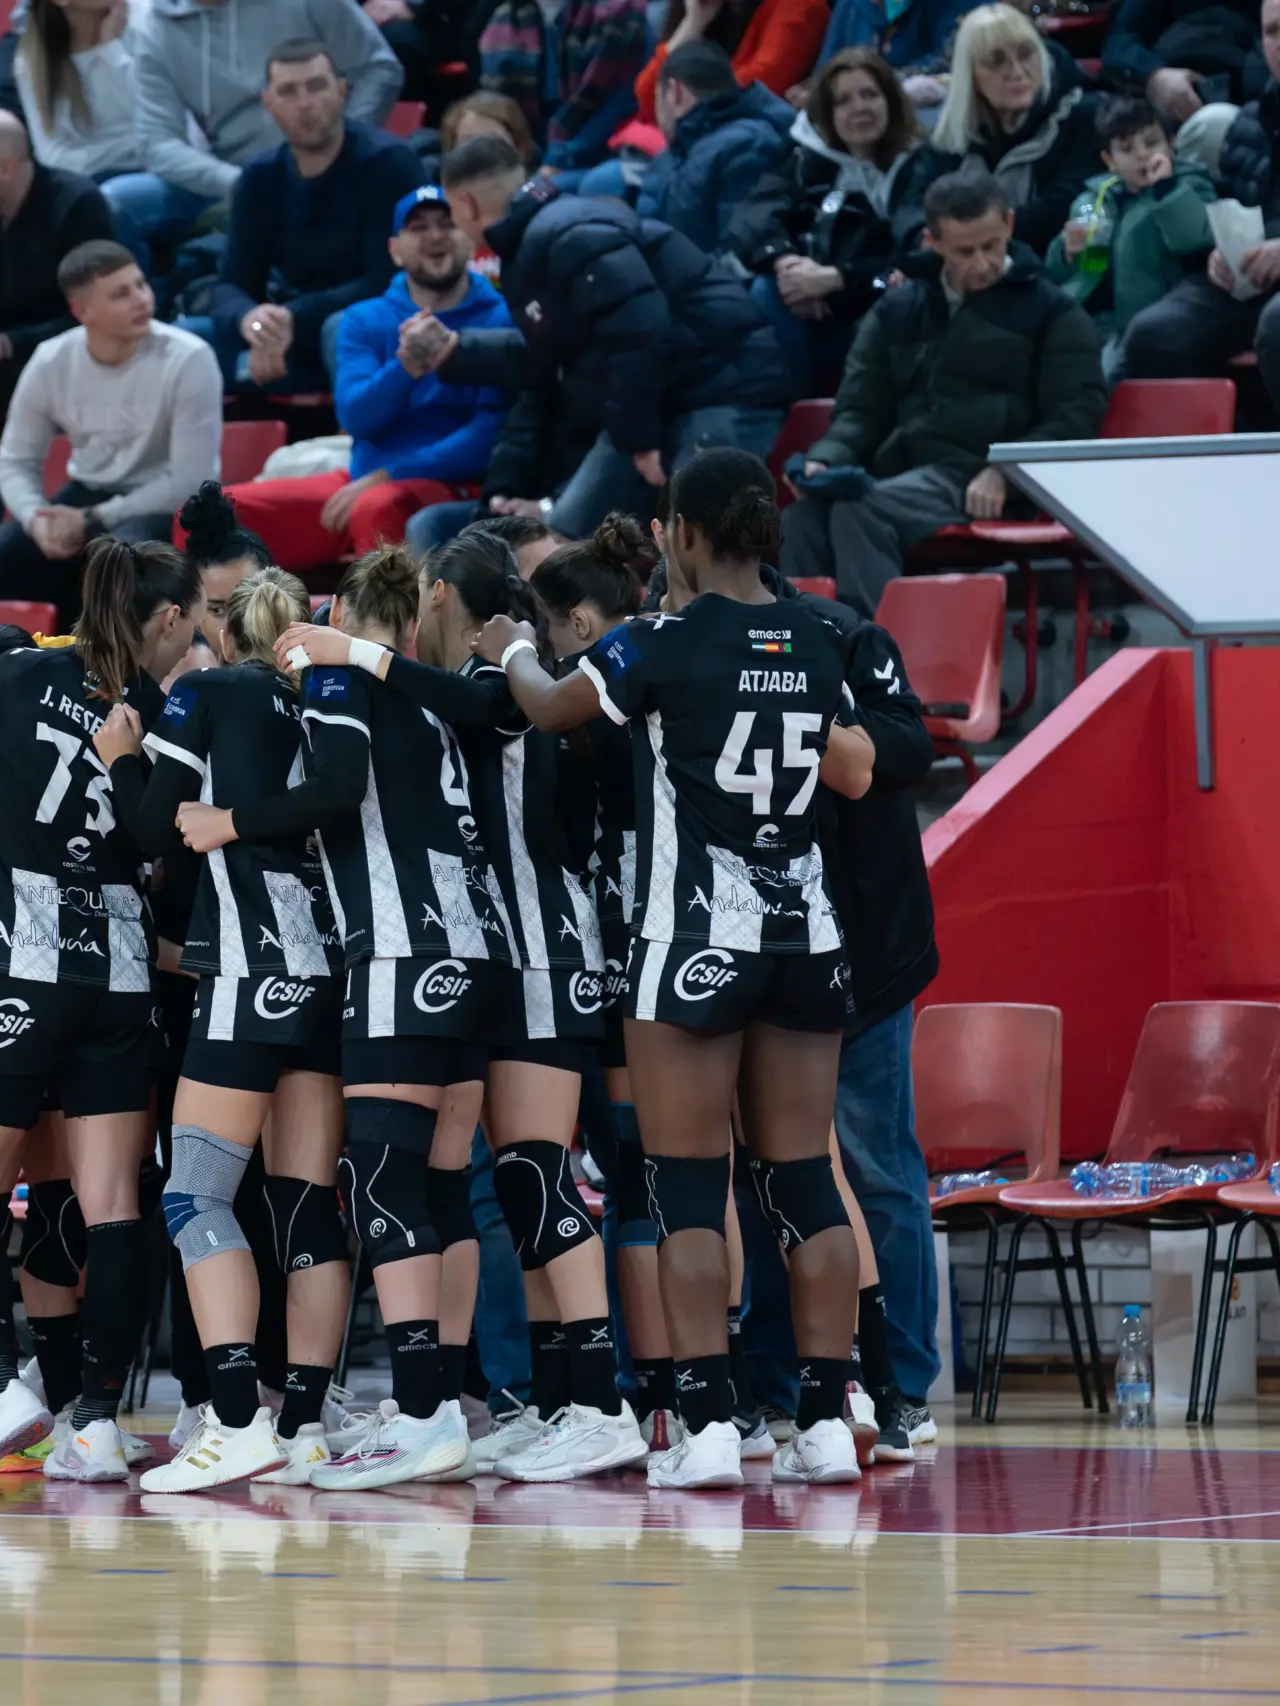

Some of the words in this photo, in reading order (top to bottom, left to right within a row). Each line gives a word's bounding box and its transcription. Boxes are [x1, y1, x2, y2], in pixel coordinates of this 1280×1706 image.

[738, 670, 808, 693] ATJABA
[40, 685, 54, 707] J.
[272, 695, 290, 717] N.
[715, 711, 822, 815] 45
[426, 974, 472, 996] CSIF
[686, 962, 738, 988] CSIF
[267, 981, 315, 1004] CSIF
